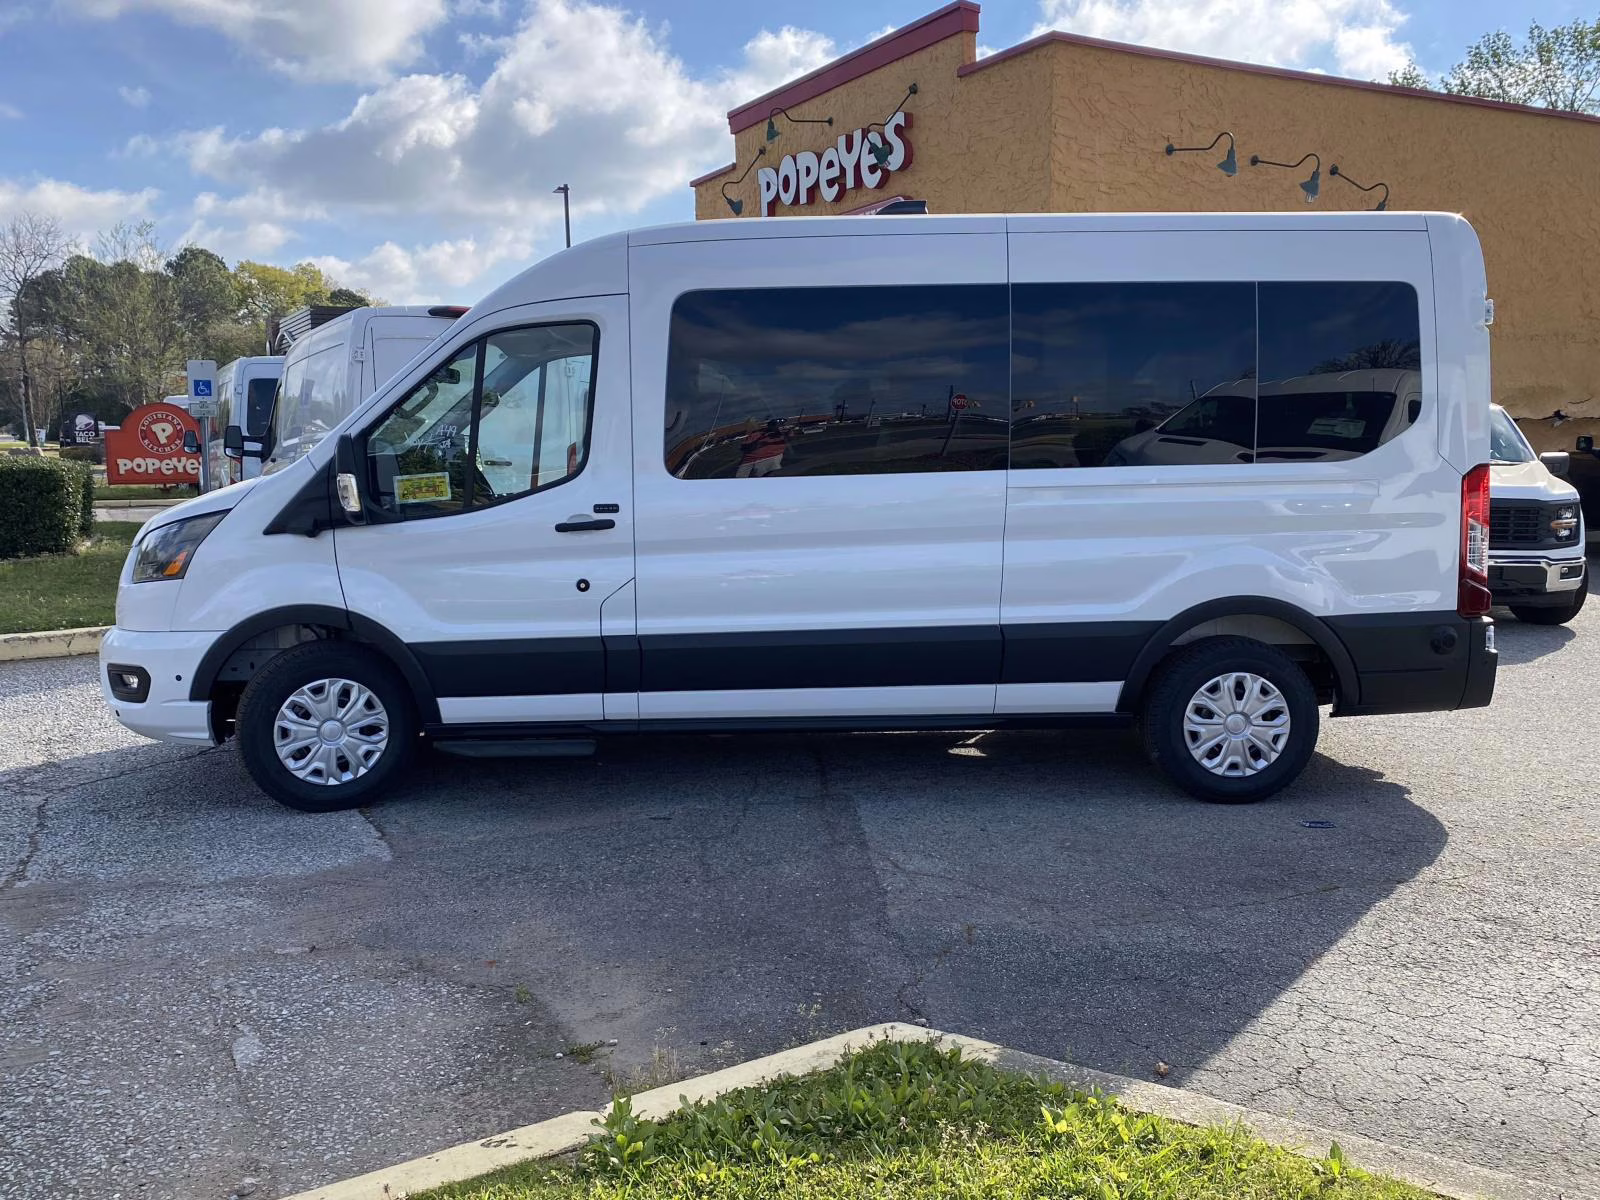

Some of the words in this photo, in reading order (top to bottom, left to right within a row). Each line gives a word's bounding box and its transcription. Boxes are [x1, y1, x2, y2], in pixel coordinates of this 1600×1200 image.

[141, 413, 182, 431] LOUISIANA
[150, 422, 174, 444] P
[143, 438, 181, 452] KITCHEN
[116, 457, 202, 475] POPeYe
